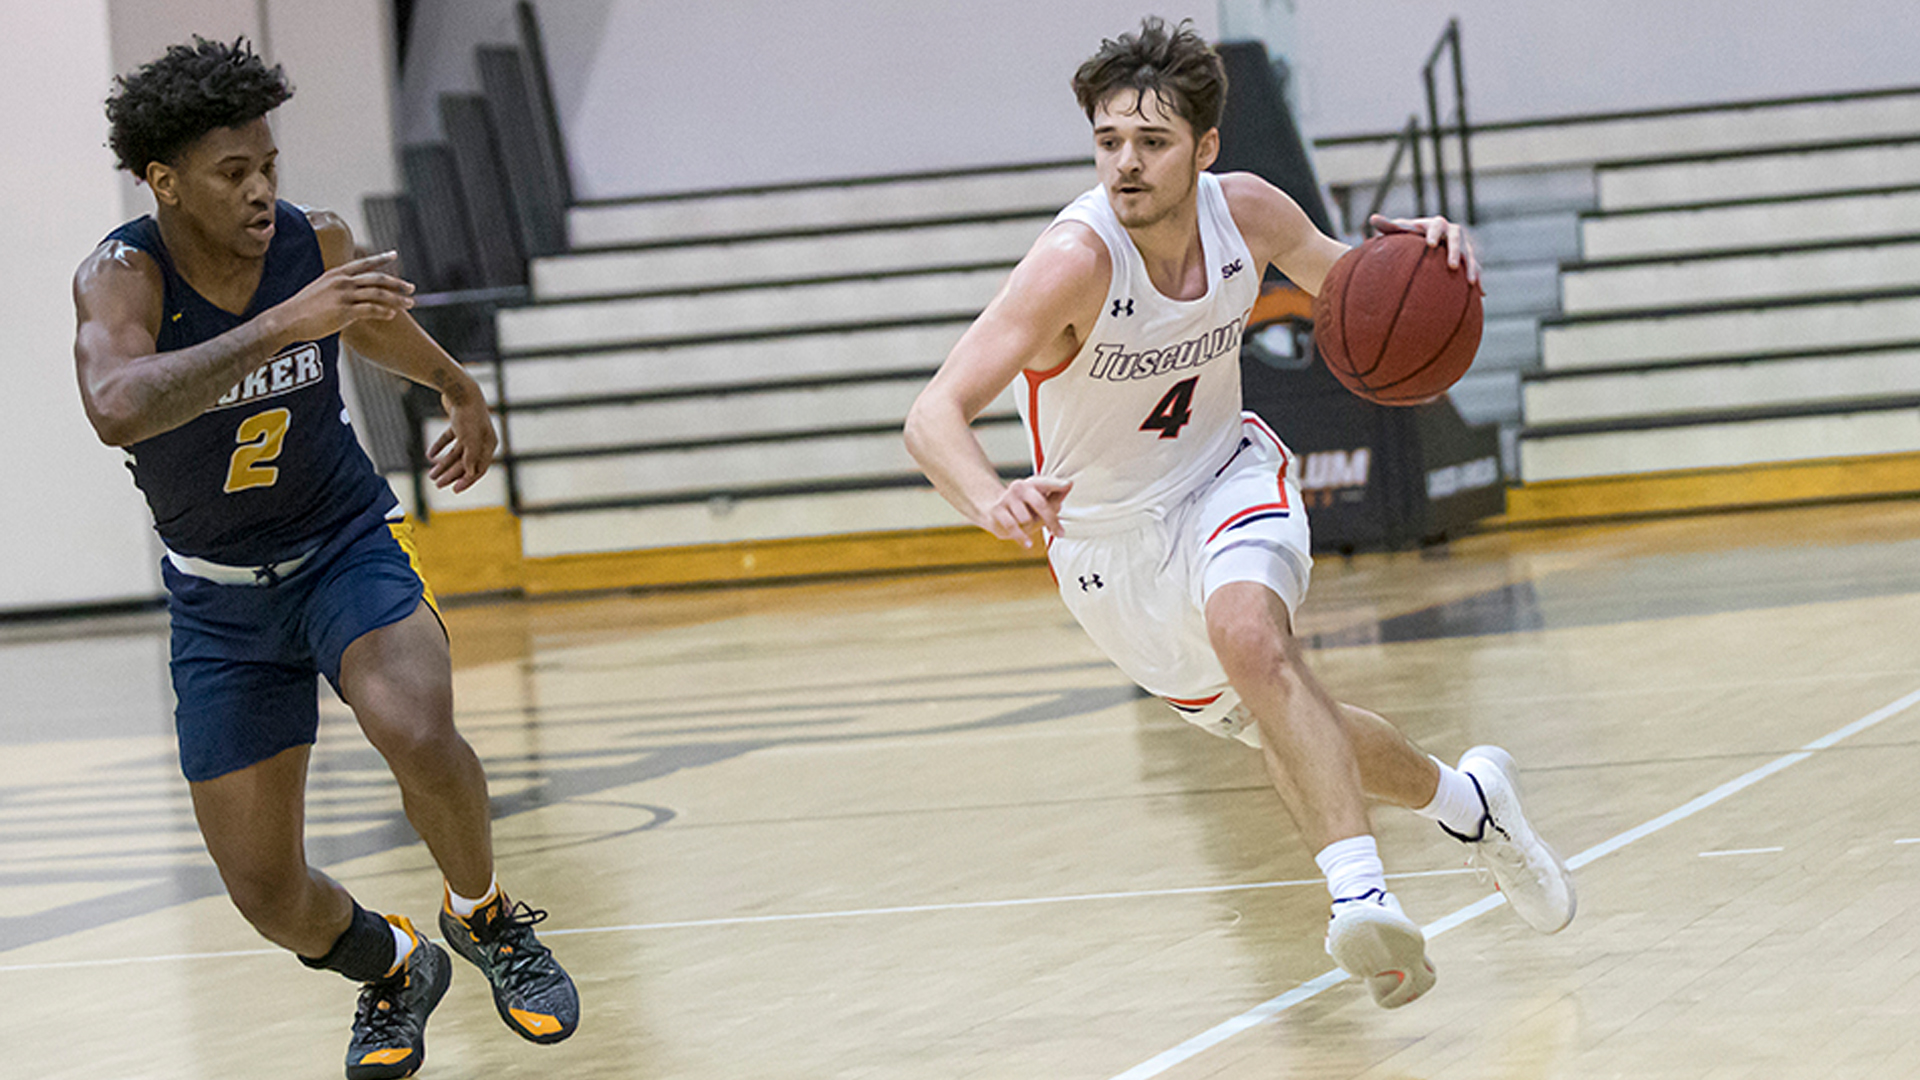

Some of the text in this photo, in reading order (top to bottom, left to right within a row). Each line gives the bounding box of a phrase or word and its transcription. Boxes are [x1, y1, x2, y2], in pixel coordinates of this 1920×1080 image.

[1221, 258, 1243, 279] SAC
[1138, 374, 1201, 440] 4
[223, 407, 292, 494] 2
